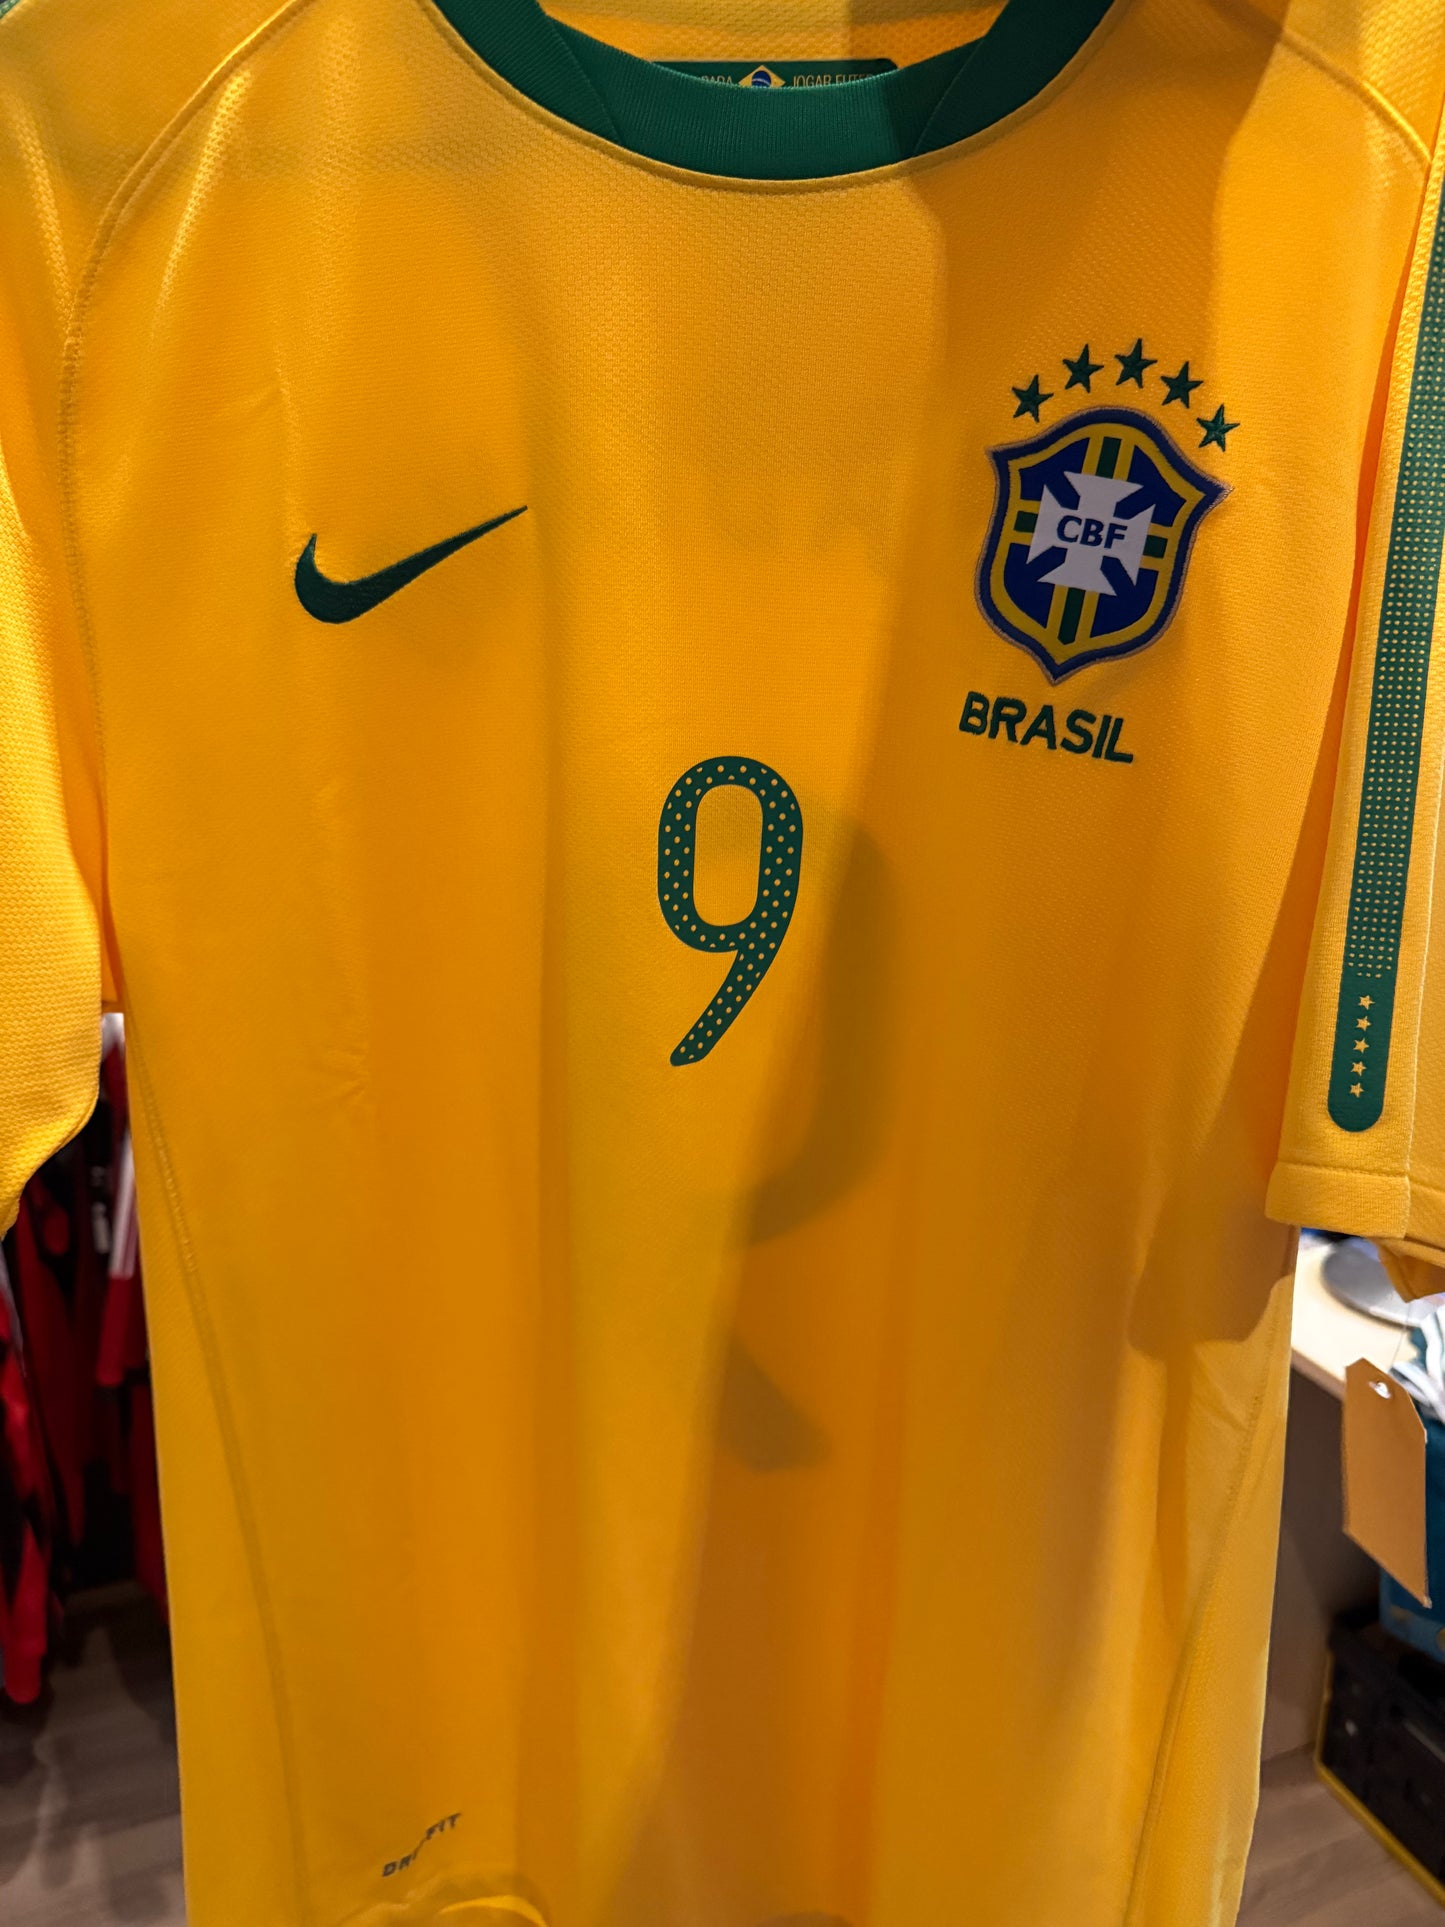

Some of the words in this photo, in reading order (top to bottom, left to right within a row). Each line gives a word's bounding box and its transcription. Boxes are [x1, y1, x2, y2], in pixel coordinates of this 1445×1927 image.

[1056, 515, 1129, 550] CBF
[958, 691, 1134, 764] BRASIL
[657, 755, 804, 1067] 9
